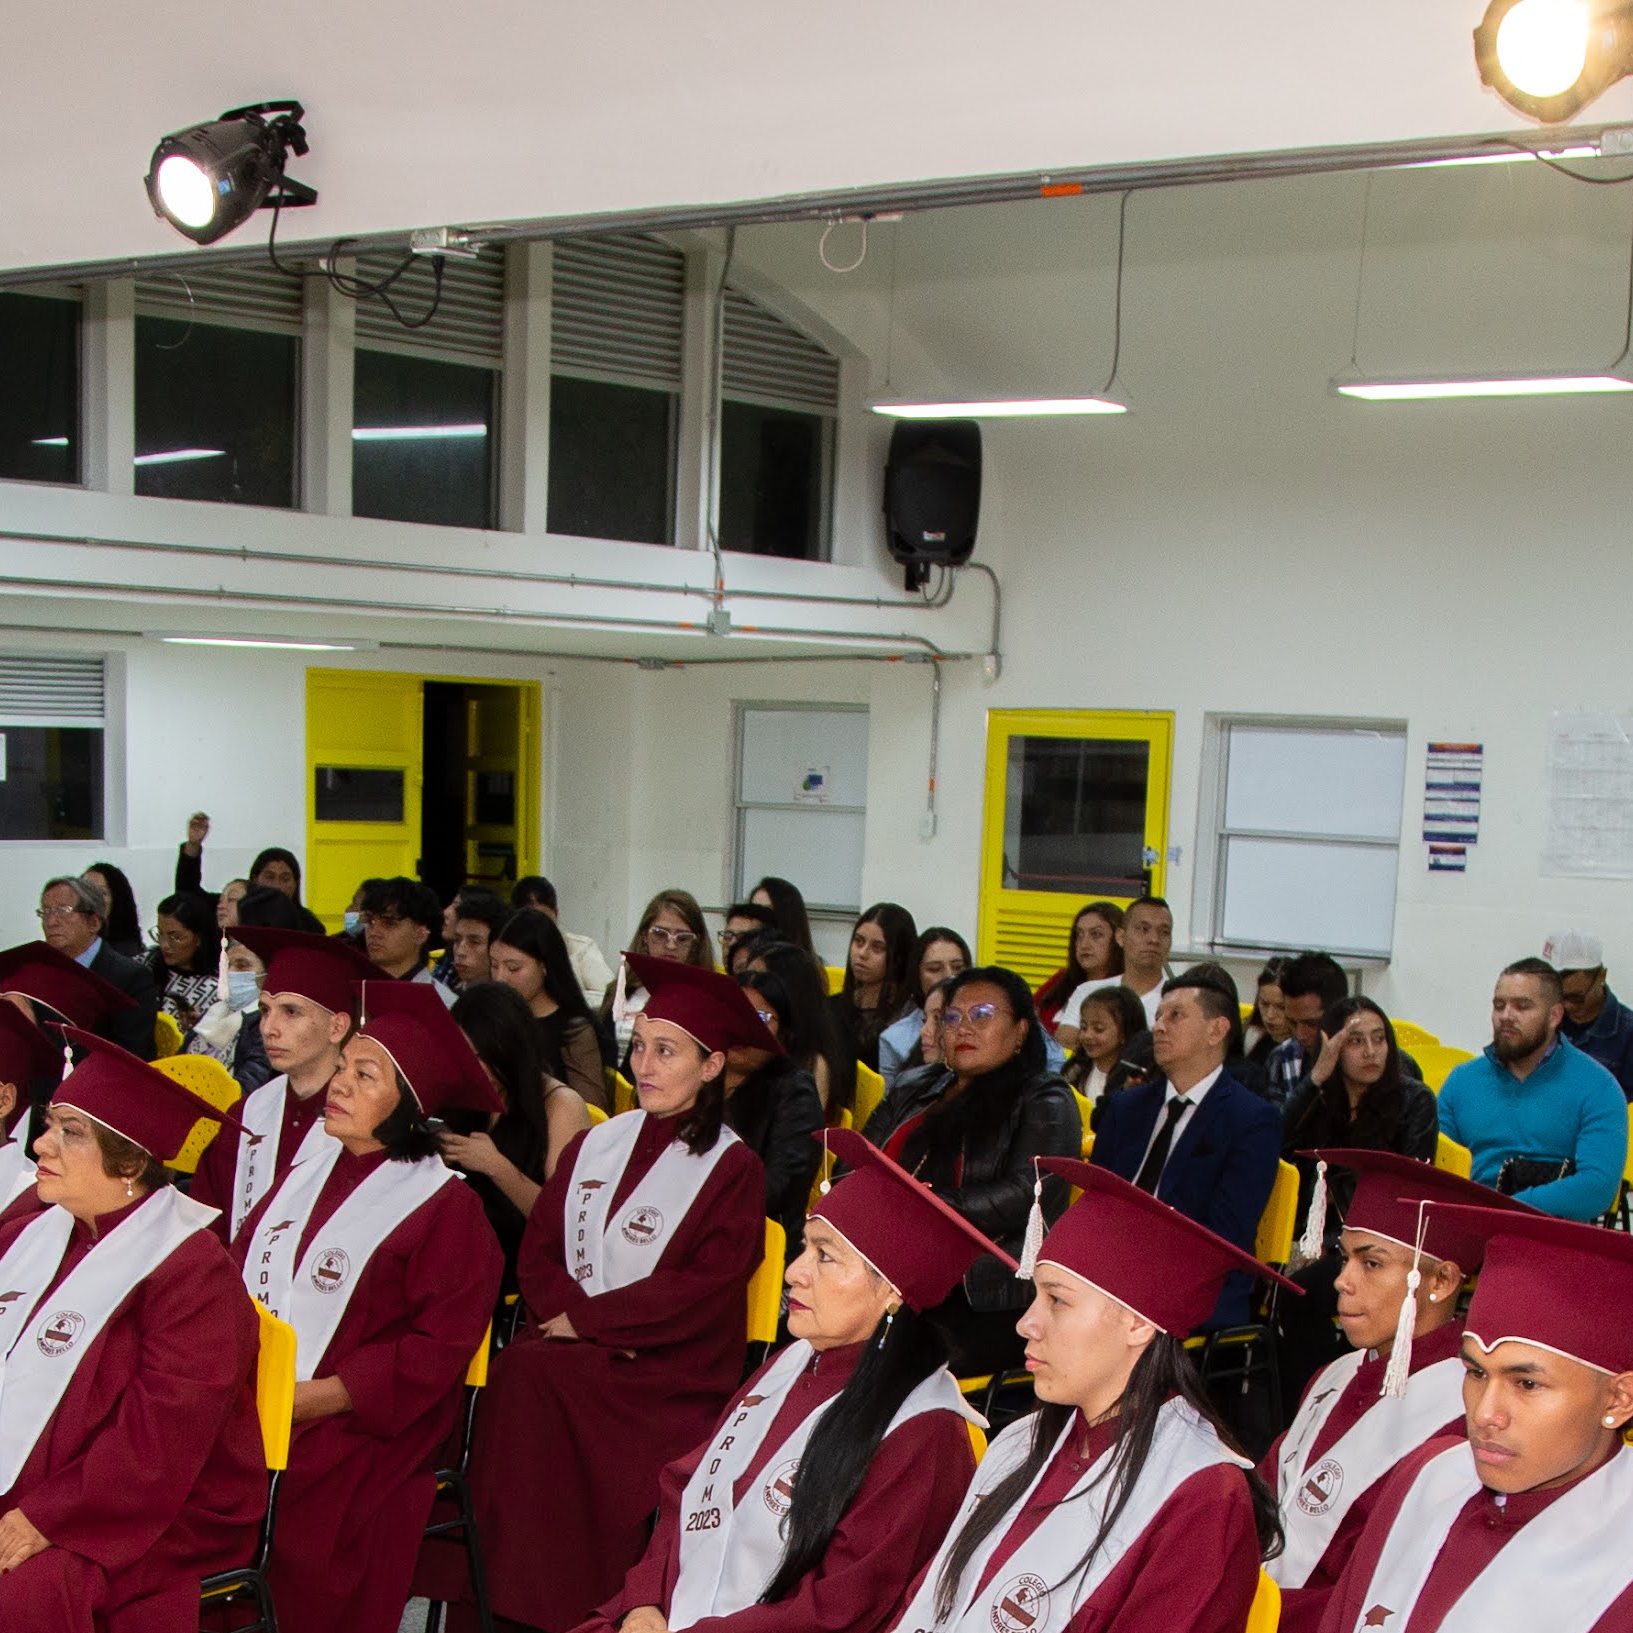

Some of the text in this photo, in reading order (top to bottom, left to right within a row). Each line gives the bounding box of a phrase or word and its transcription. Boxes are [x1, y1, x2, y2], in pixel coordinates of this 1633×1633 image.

[576, 1193, 592, 1261] PROM
[257, 1235, 280, 1304] PROM
[701, 1412, 748, 1503] PROM
[685, 1507, 721, 1531] 2023
[764, 1485, 780, 1512] ANDRES
[1019, 1576, 1046, 1597] COLEGIO
